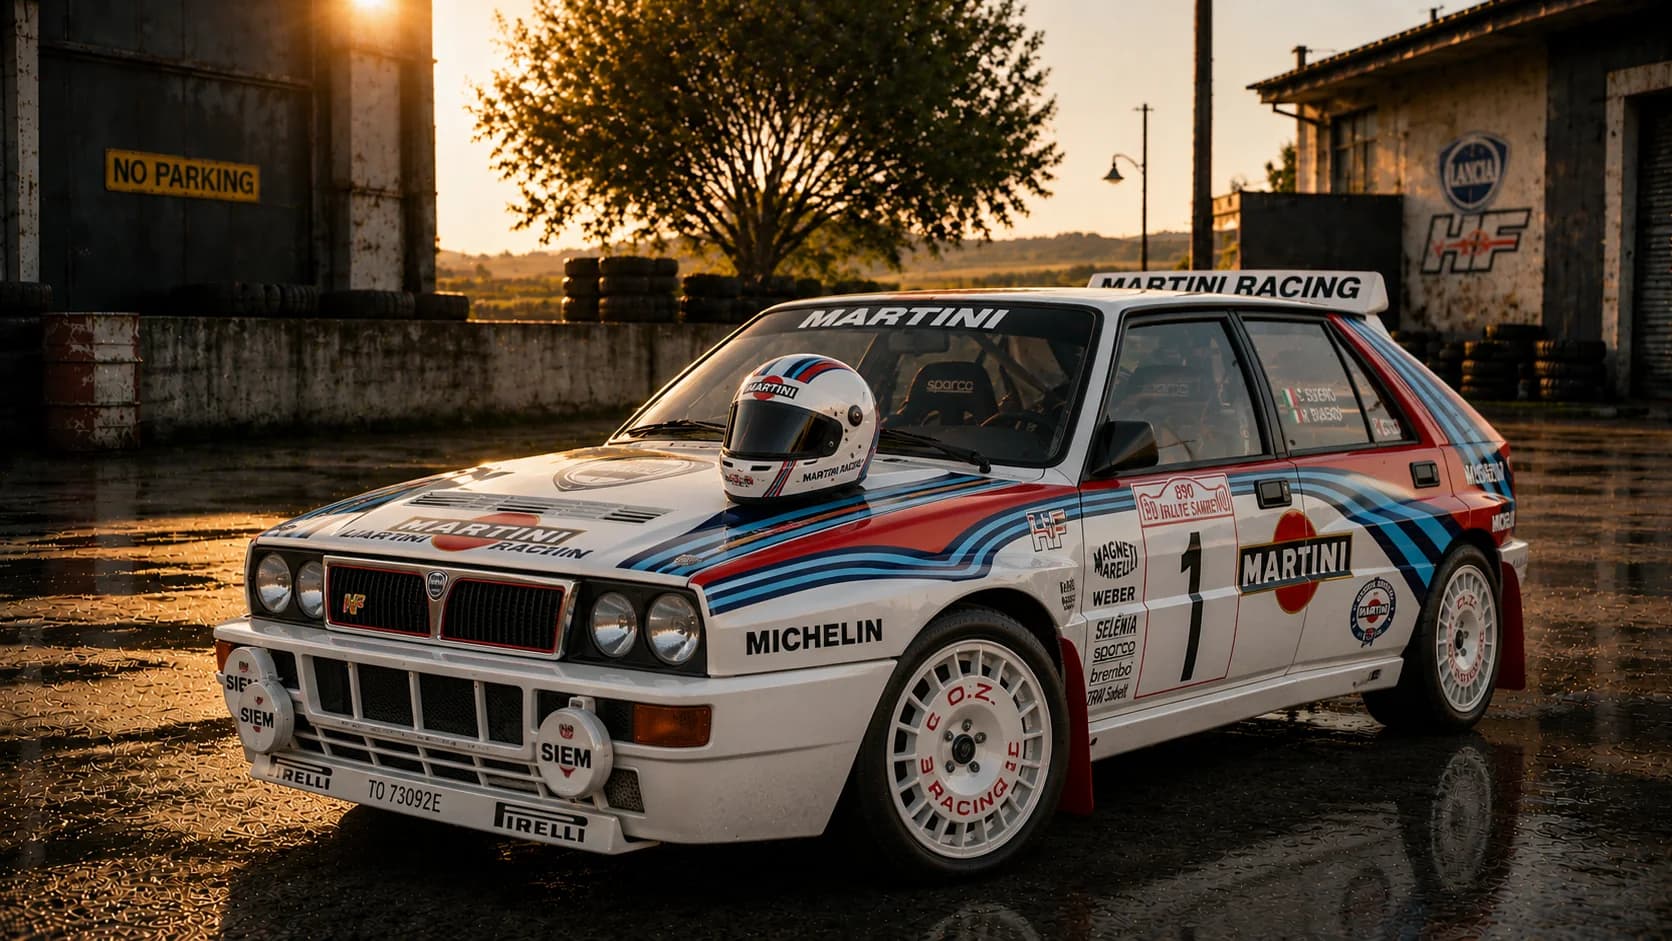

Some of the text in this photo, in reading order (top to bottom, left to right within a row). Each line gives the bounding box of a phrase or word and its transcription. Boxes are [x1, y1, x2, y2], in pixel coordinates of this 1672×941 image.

[113, 157, 254, 194] NO PARKING
[1420, 208, 1533, 274] HF
[1234, 275, 1361, 299] RACING
[798, 307, 1010, 329] MARTINI
[927, 379, 975, 393] sparco
[399, 518, 572, 545] MARTINI
[1093, 540, 1138, 566] MAGNETI
[1242, 541, 1347, 587] MARTINI
[1093, 586, 1135, 607] WEBER
[1180, 532, 1204, 682] 1
[746, 618, 883, 656] MICHELIN
[1090, 661, 1133, 683] brembo
[947, 682, 996, 706] O.Z.
[240, 706, 274, 729] SIEM
[541, 742, 592, 768] SIEM
[368, 779, 442, 813] TO 73092E
[928, 777, 1009, 817] RACING
[494, 801, 588, 843] PIRELLI
